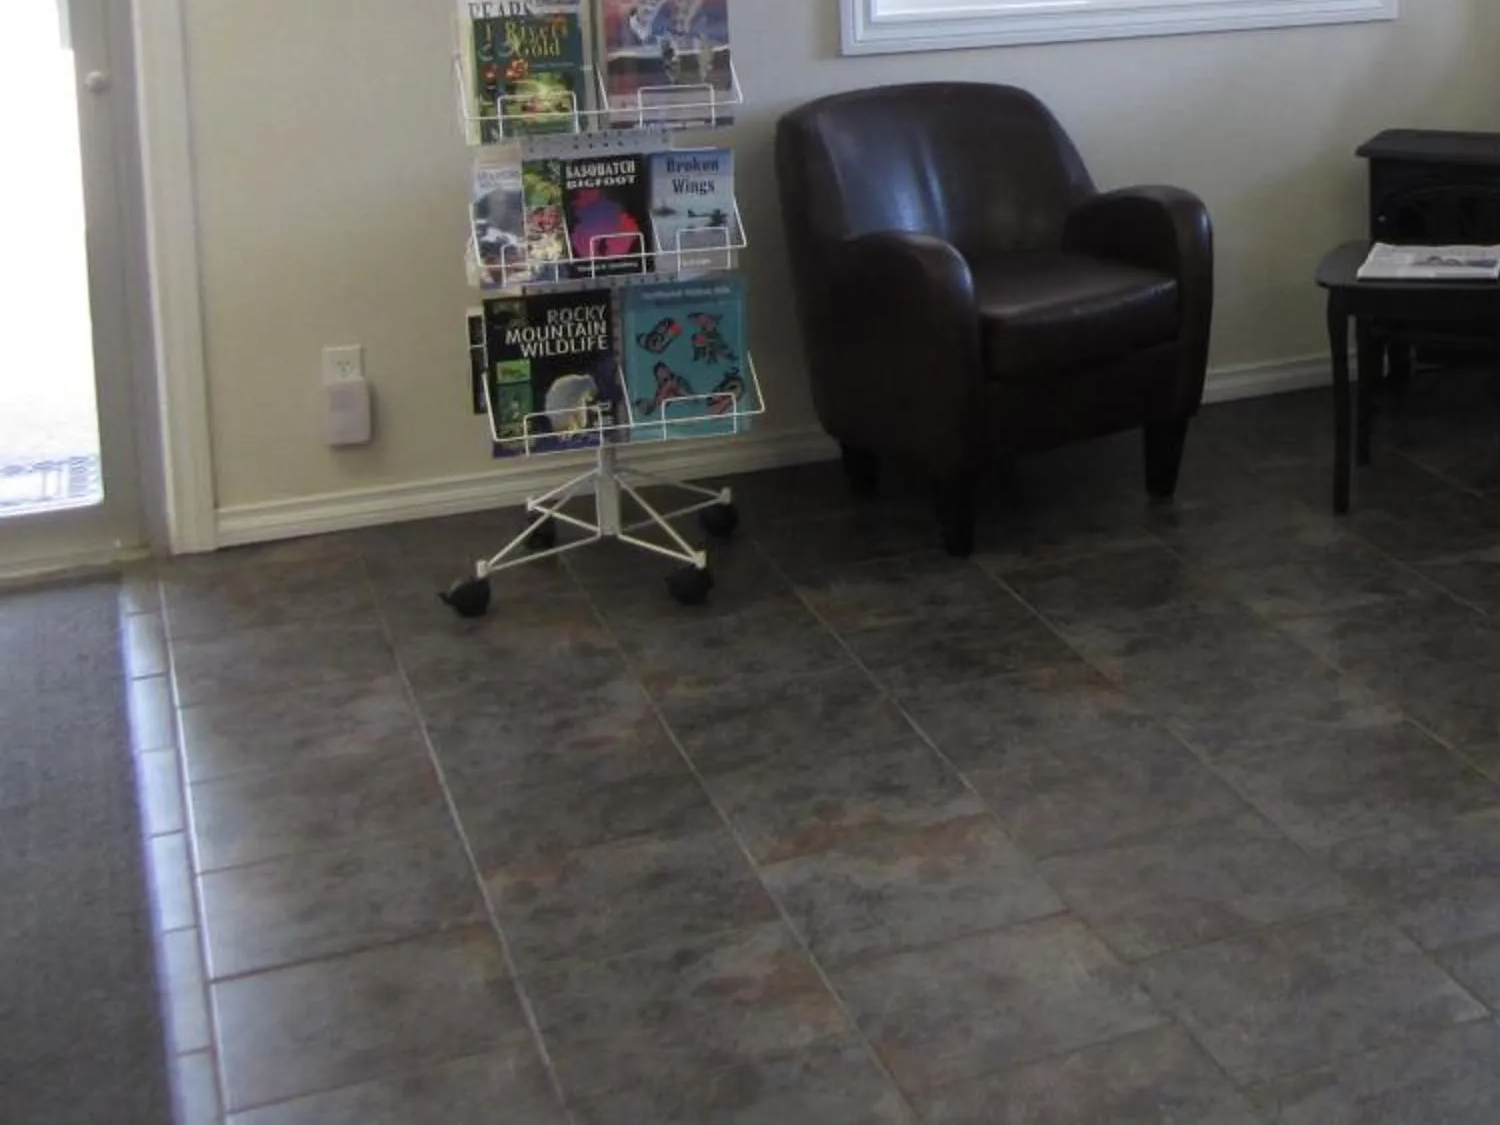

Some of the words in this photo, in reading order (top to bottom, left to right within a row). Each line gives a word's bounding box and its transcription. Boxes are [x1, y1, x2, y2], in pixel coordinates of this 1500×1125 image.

[565, 160, 635, 179] SASQUATCH
[666, 156, 720, 174] Broken
[566, 176, 636, 189] BIGFOOT
[672, 178, 715, 195] Wings
[547, 303, 607, 325] ROCKY
[505, 321, 607, 346] MOUNTAIN
[520, 334, 608, 359] WILDLIFE
